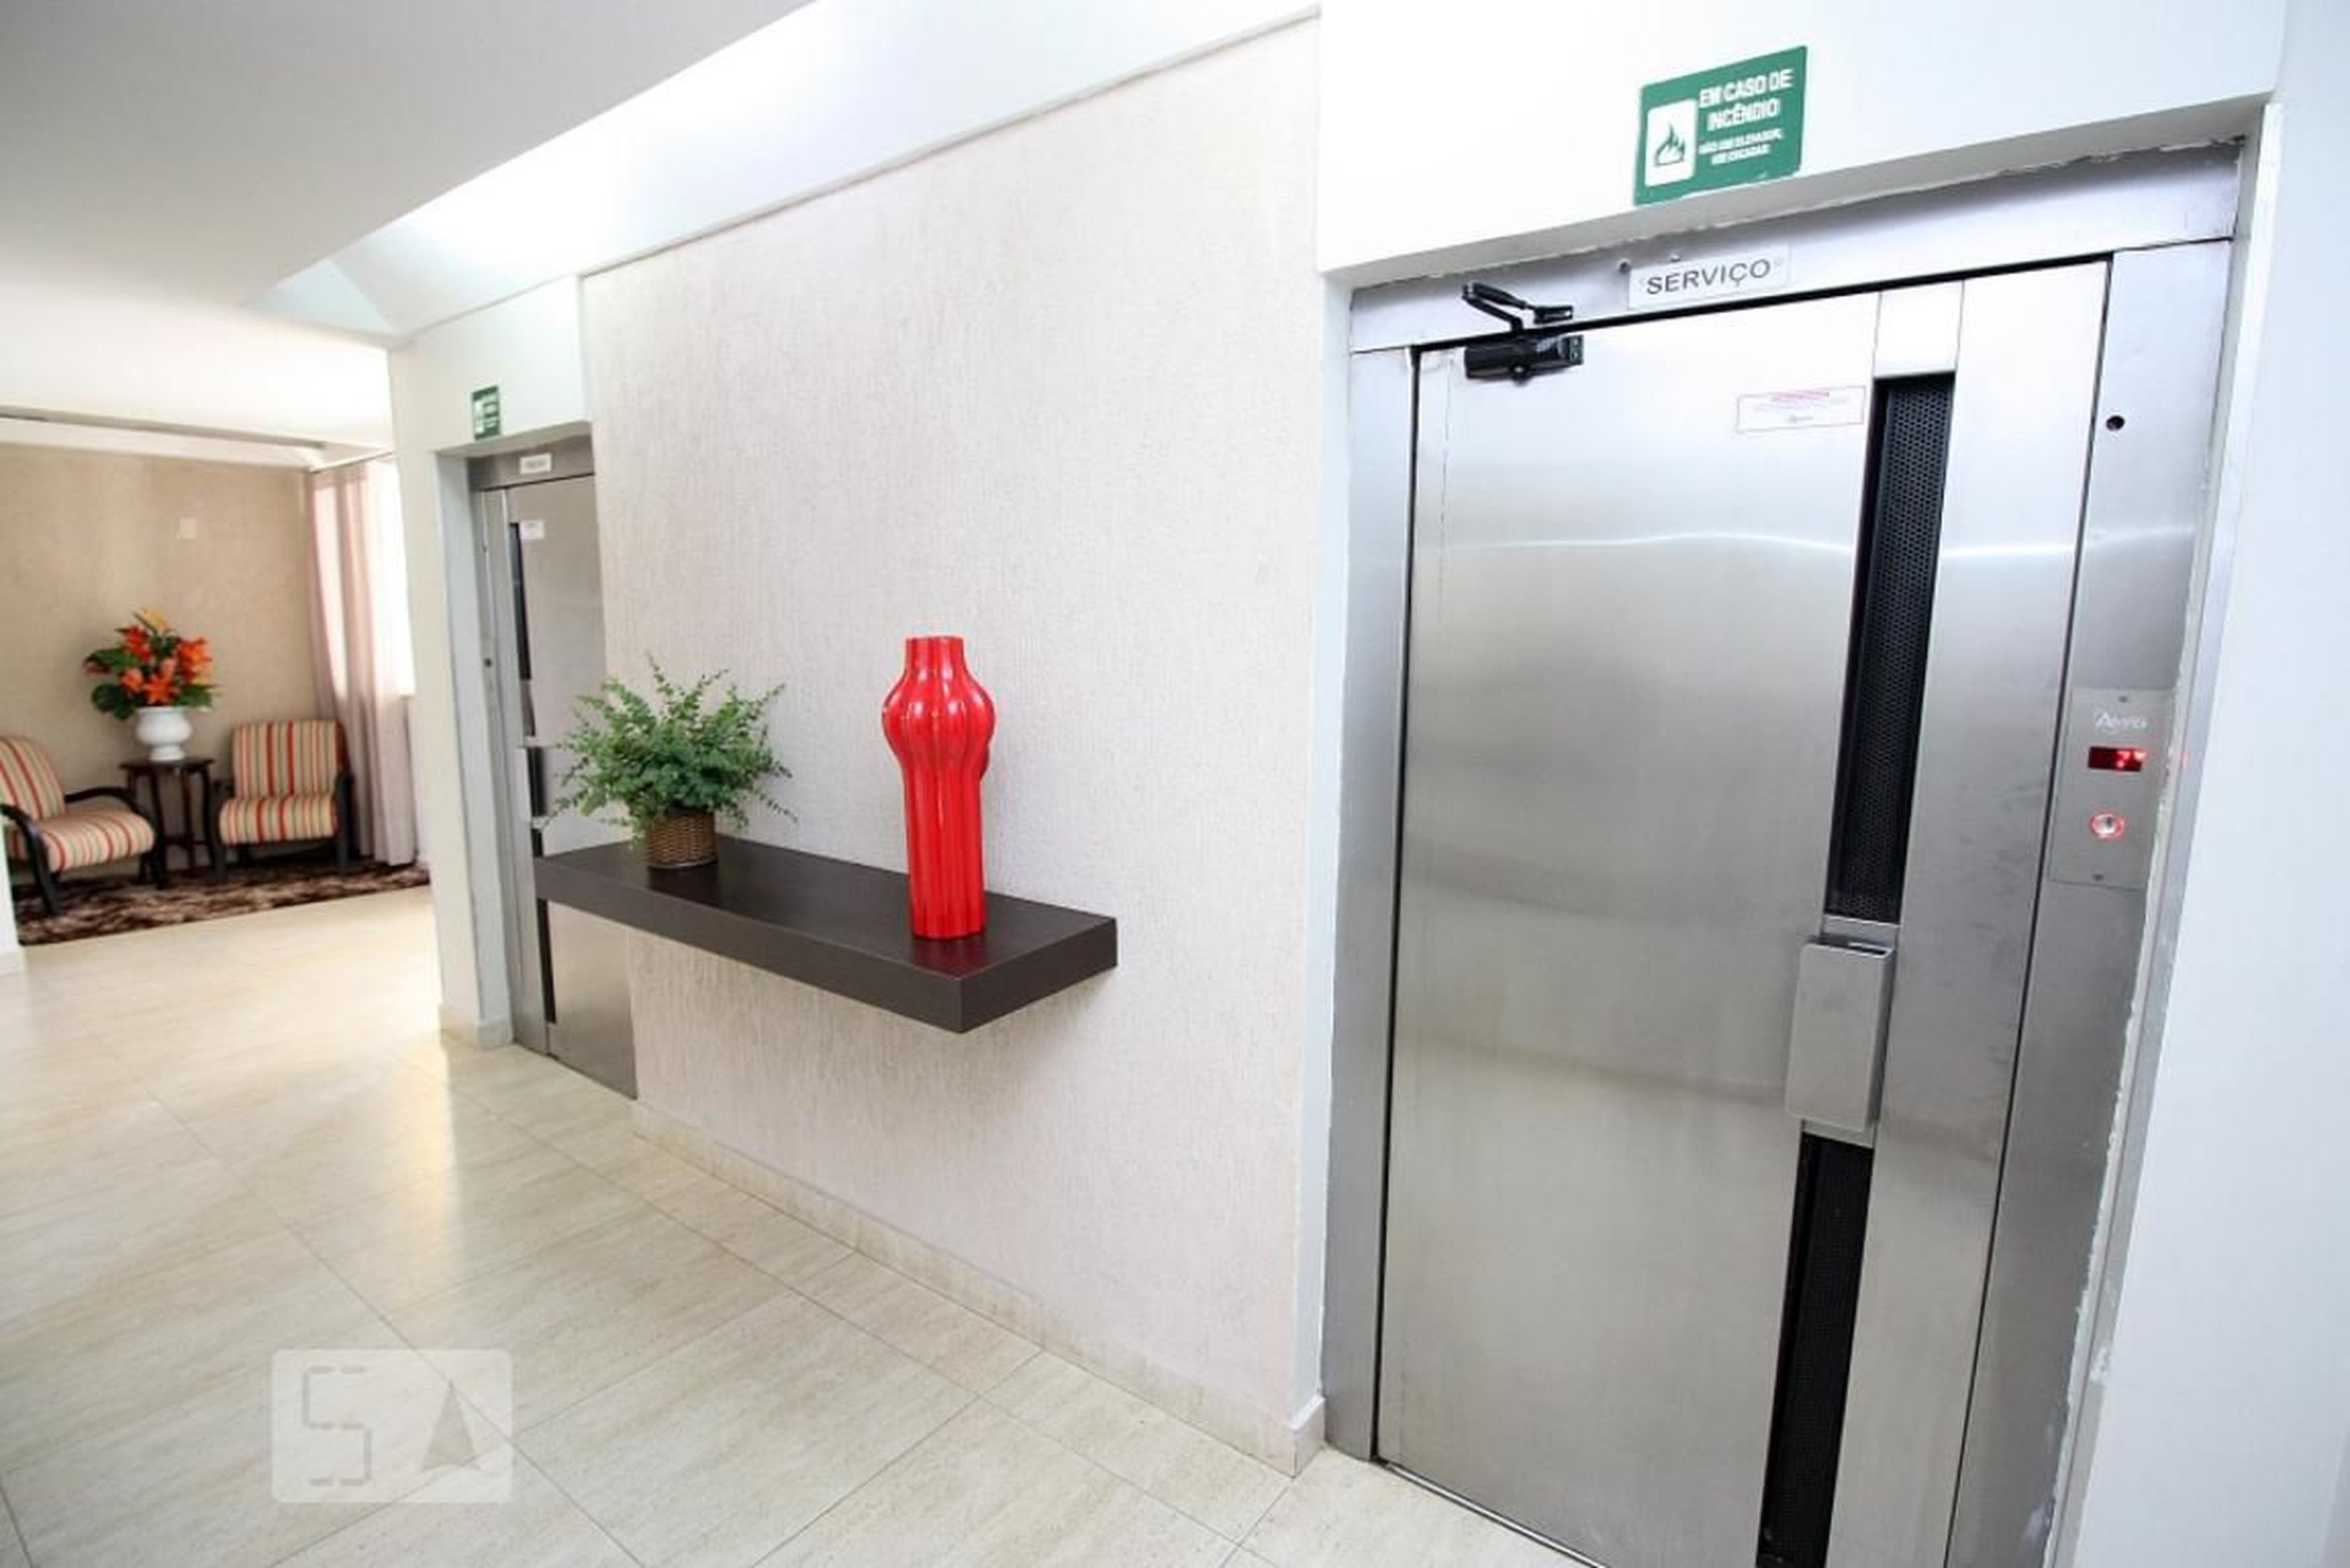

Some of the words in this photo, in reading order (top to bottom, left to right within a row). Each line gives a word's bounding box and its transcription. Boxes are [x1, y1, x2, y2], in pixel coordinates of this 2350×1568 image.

[1699, 86, 1721, 108] EM
[1723, 75, 1767, 102] CASO
[1769, 68, 1794, 91] DE
[1707, 98, 1780, 131] INCÊNDIO
[1646, 259, 1770, 294] SERVIÇO
